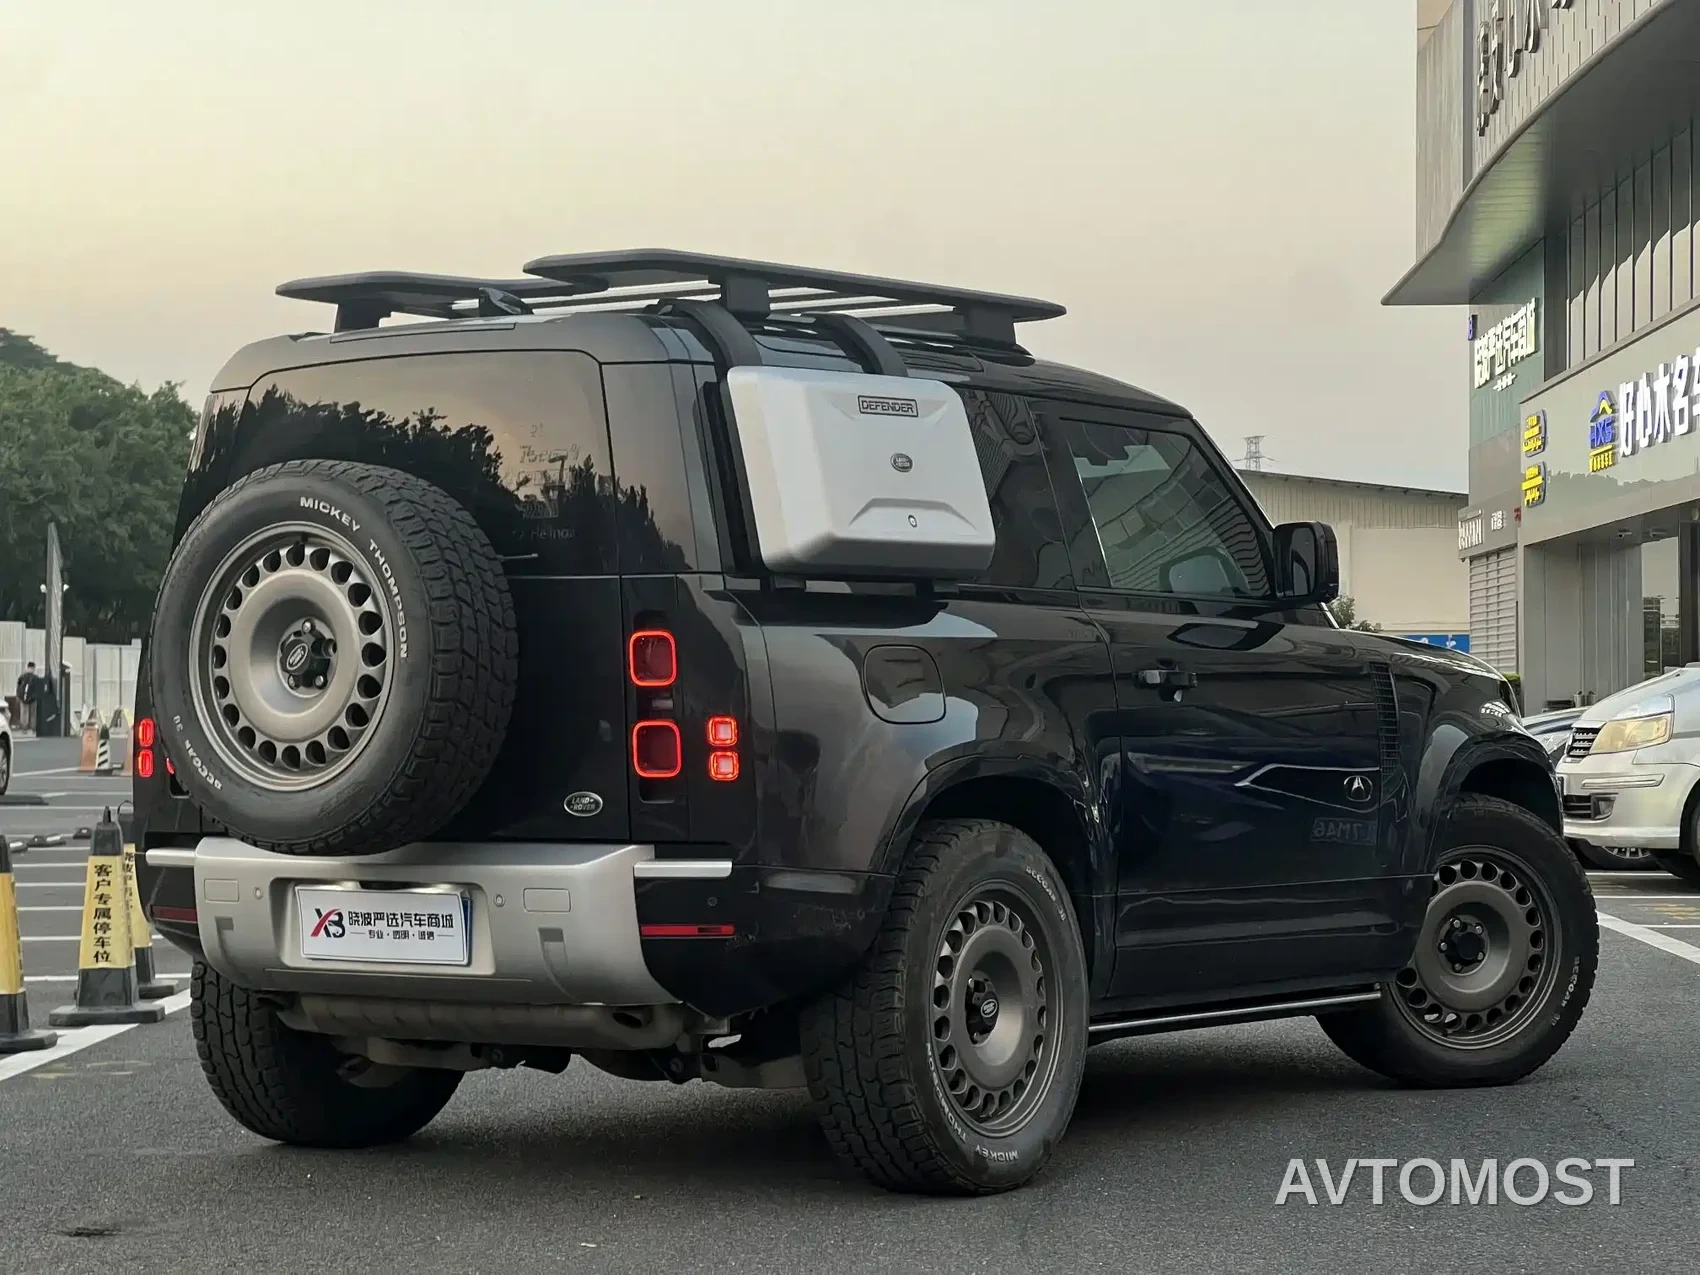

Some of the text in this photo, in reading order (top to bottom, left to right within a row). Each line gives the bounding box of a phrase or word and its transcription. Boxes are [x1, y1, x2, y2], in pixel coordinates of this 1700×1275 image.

[861, 400, 914, 413] DEFENDER
[300, 497, 408, 659] MICKEY THOMPSON
[93, 864, 112, 964] 客户专属停车位
[348, 911, 454, 929] 晓波严选汽车商城
[975, 1144, 1019, 1163] MICKEY
